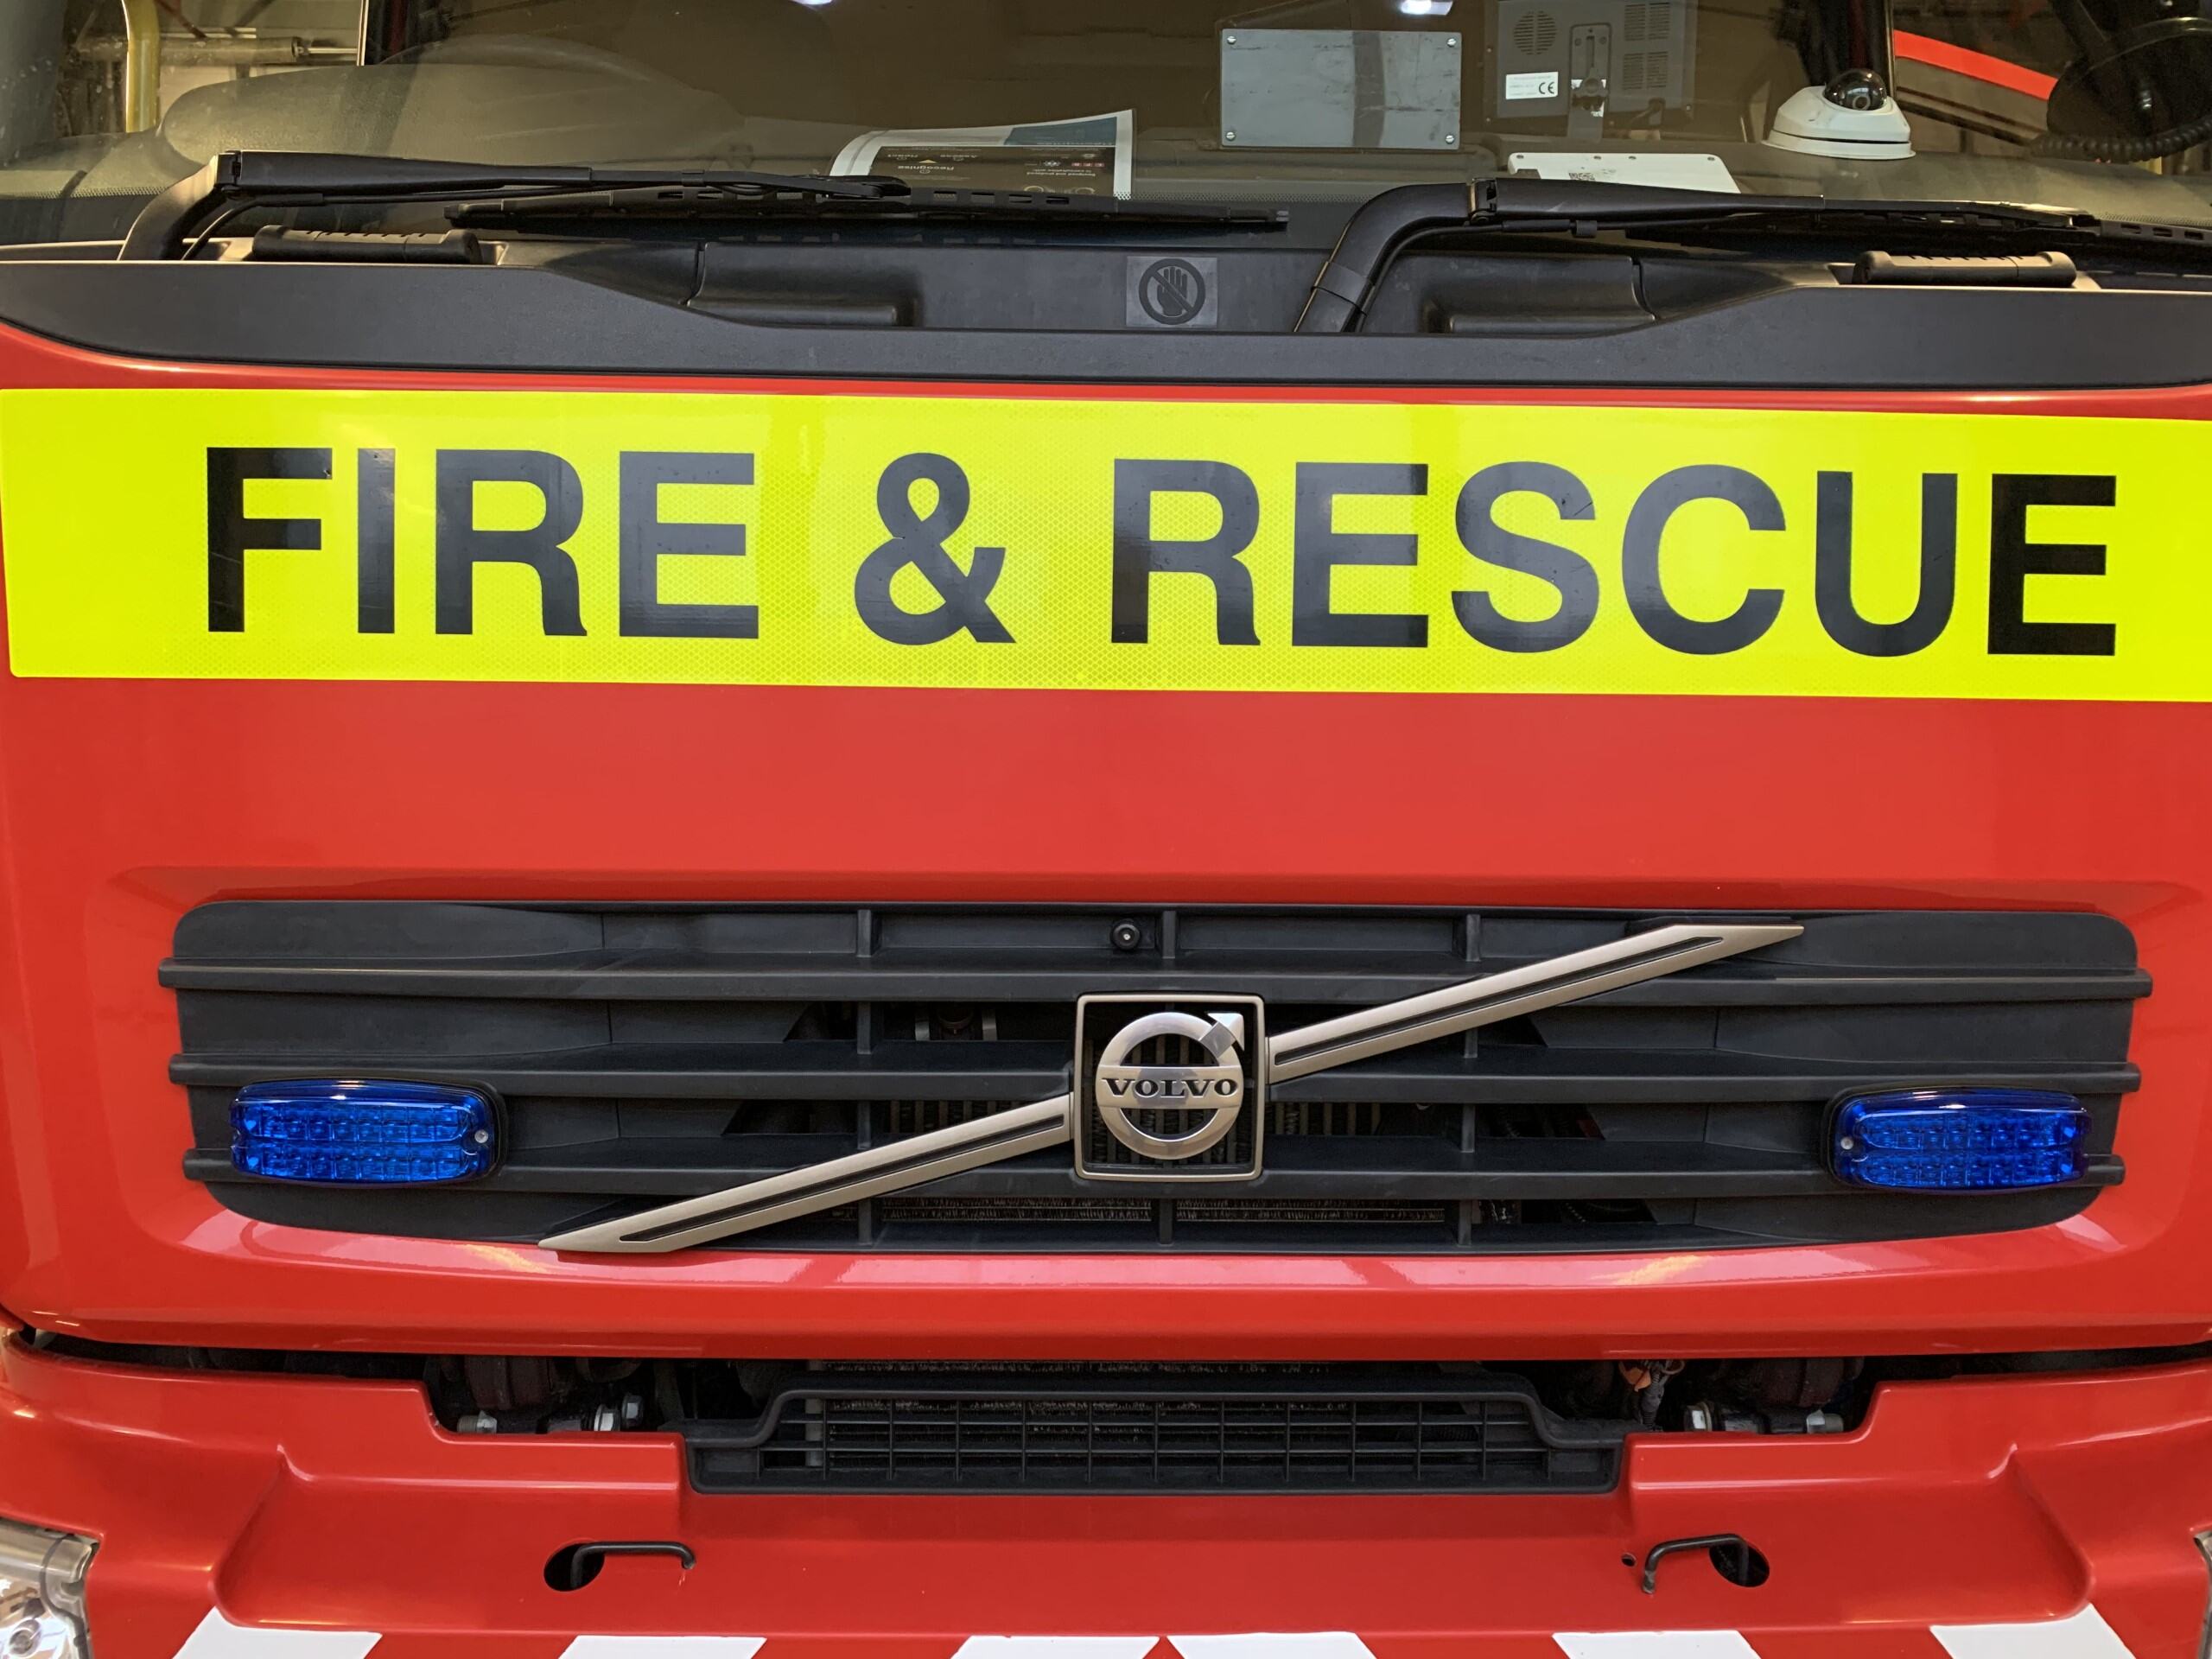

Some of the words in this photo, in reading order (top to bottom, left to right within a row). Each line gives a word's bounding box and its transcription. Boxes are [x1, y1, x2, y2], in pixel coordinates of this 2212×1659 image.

[207, 448, 758, 639] FIRE
[855, 453, 1016, 645] &
[1111, 460, 2116, 657] RESCUE
[1103, 1078, 1238, 1097] VOLVO
